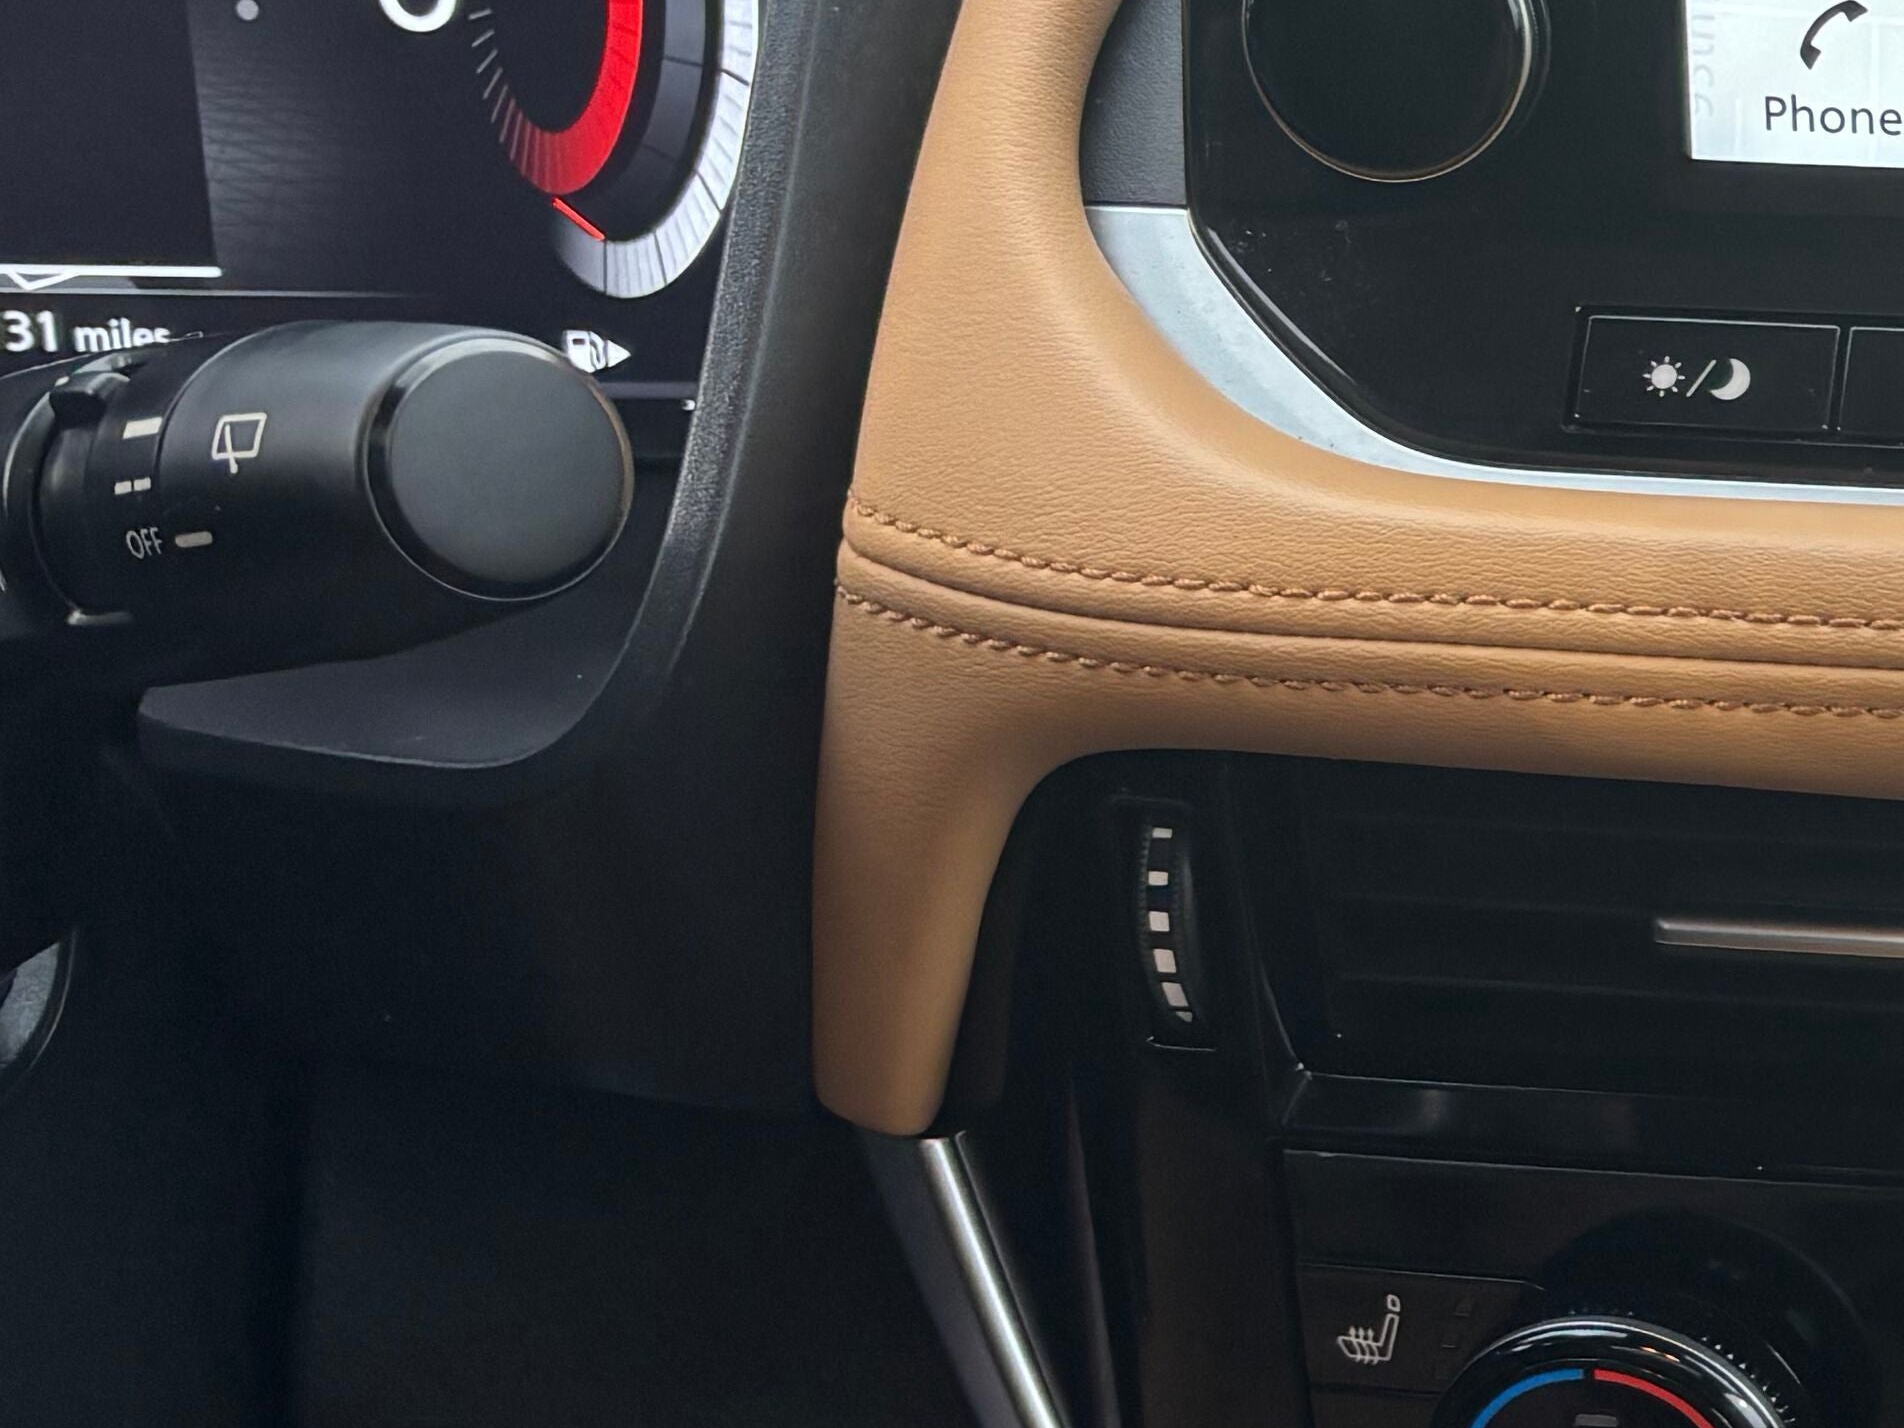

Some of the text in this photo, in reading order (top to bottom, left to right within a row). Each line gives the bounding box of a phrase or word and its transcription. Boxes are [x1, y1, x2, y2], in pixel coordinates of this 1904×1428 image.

[1764, 93, 1903, 136] Phone
[0, 308, 59, 353] 31
[125, 526, 163, 560] OFF
